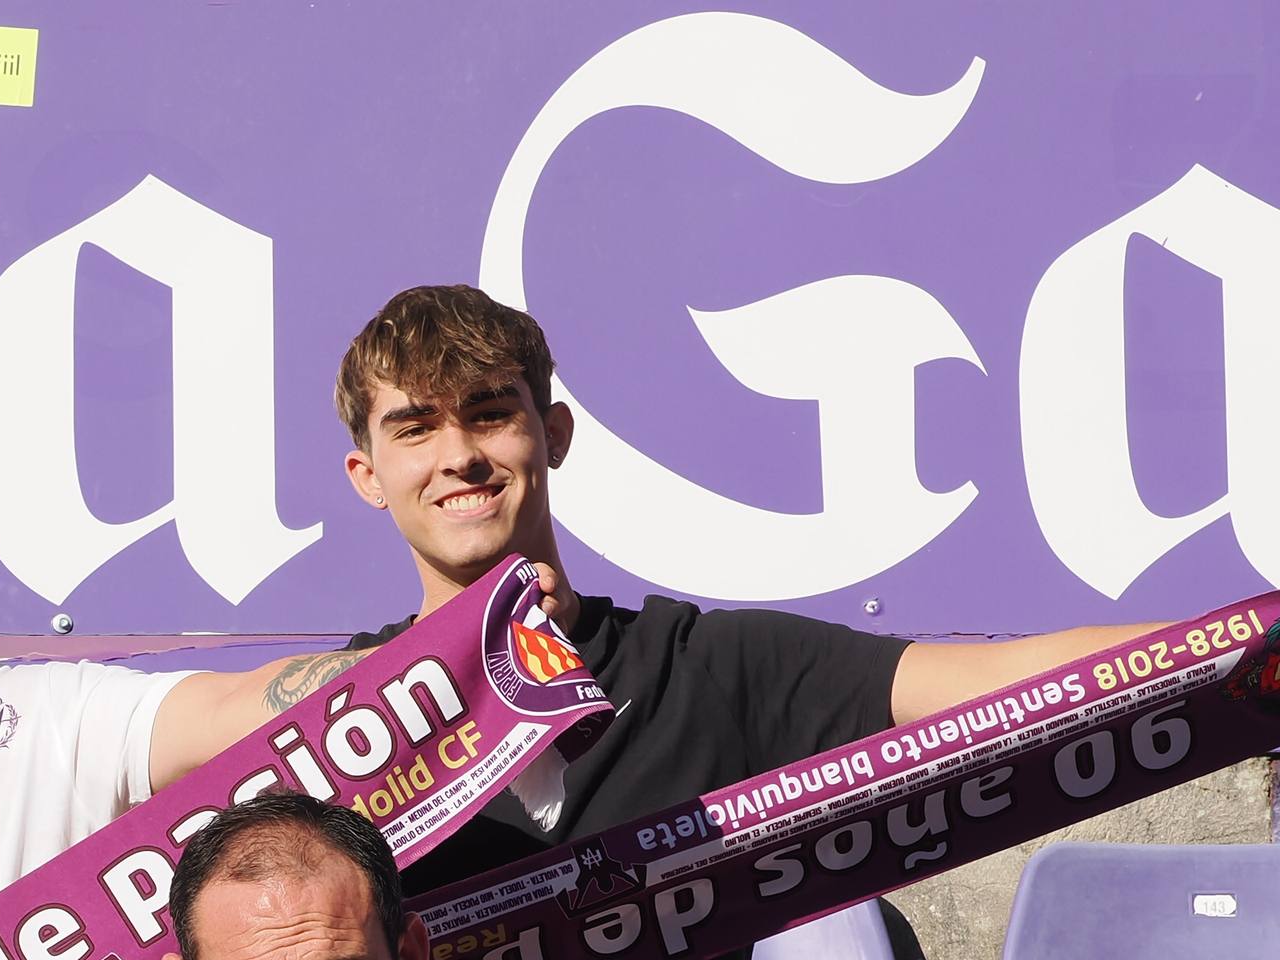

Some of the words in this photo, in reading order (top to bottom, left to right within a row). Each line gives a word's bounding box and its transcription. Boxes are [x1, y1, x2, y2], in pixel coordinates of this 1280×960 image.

[1093, 609, 1265, 690] 1928-2018
[486, 650, 523, 702] FPRV
[1185, 662, 1217, 680] ARÉVALO
[1136, 675, 1180, 697] TORDESILLAS
[1082, 692, 1131, 716] VALDESTILLAS
[881, 673, 1086, 763] Sentimiento
[1044, 712, 1079, 730] KOMANDO
[1002, 737, 1012, 746] LA
[1016, 725, 1044, 741] VIOLETA
[437, 720, 483, 770] CF
[1052, 699, 1193, 799] 90
[935, 756, 960, 771] BIENVE
[960, 752, 971, 761] DE
[963, 756, 990, 771] FRENTE
[406, 801, 434, 824] MEDINA
[431, 793, 445, 807] DEL
[443, 777, 468, 799] CAMPO
[469, 765, 485, 780] PESI
[482, 753, 498, 769] VAYA
[495, 740, 510, 756] TELA
[414, 823, 426, 835] EN
[422, 804, 450, 829] CORUÑA
[452, 797, 463, 808] LA
[461, 789, 475, 802] OLA
[476, 756, 511, 789] VALLADOLID
[507, 742, 525, 761] AWAY
[522, 727, 539, 745] 1928
[905, 767, 928, 782] DANDO
[907, 766, 963, 791] BLANQUIVIOLETA
[877, 776, 905, 792] GUERRA
[635, 750, 874, 851] blanquivioleta
[827, 788, 872, 810] LOCOMOTORA
[874, 788, 902, 803] MARCOS
[791, 806, 823, 823] SIEMPRE
[752, 828, 760, 837] EL
[754, 766, 1015, 897] años
[765, 817, 791, 833] PUCELA
[789, 815, 829, 835] PUCELANOS
[723, 832, 750, 847] MOLINO
[750, 833, 778, 847] MADRID
[778, 830, 789, 838] EN
[708, 845, 745, 863] TIBURONES
[557, 863, 573, 875] GOL
[660, 864, 693, 879] PISUERGA
[694, 858, 708, 868] DEL
[529, 868, 559, 885] VIOLETA
[498, 880, 525, 896] TUDELA
[531, 884, 553, 899] FURIA
[452, 896, 480, 912] PUCELA
[474, 891, 532, 919] BLANQUIVIOLETA
[1203, 901, 1225, 914] 143
[441, 913, 470, 931] PIRATAS
[583, 878, 715, 956] de
[430, 924, 442, 935] DE
[432, 923, 507, 960] Rea
